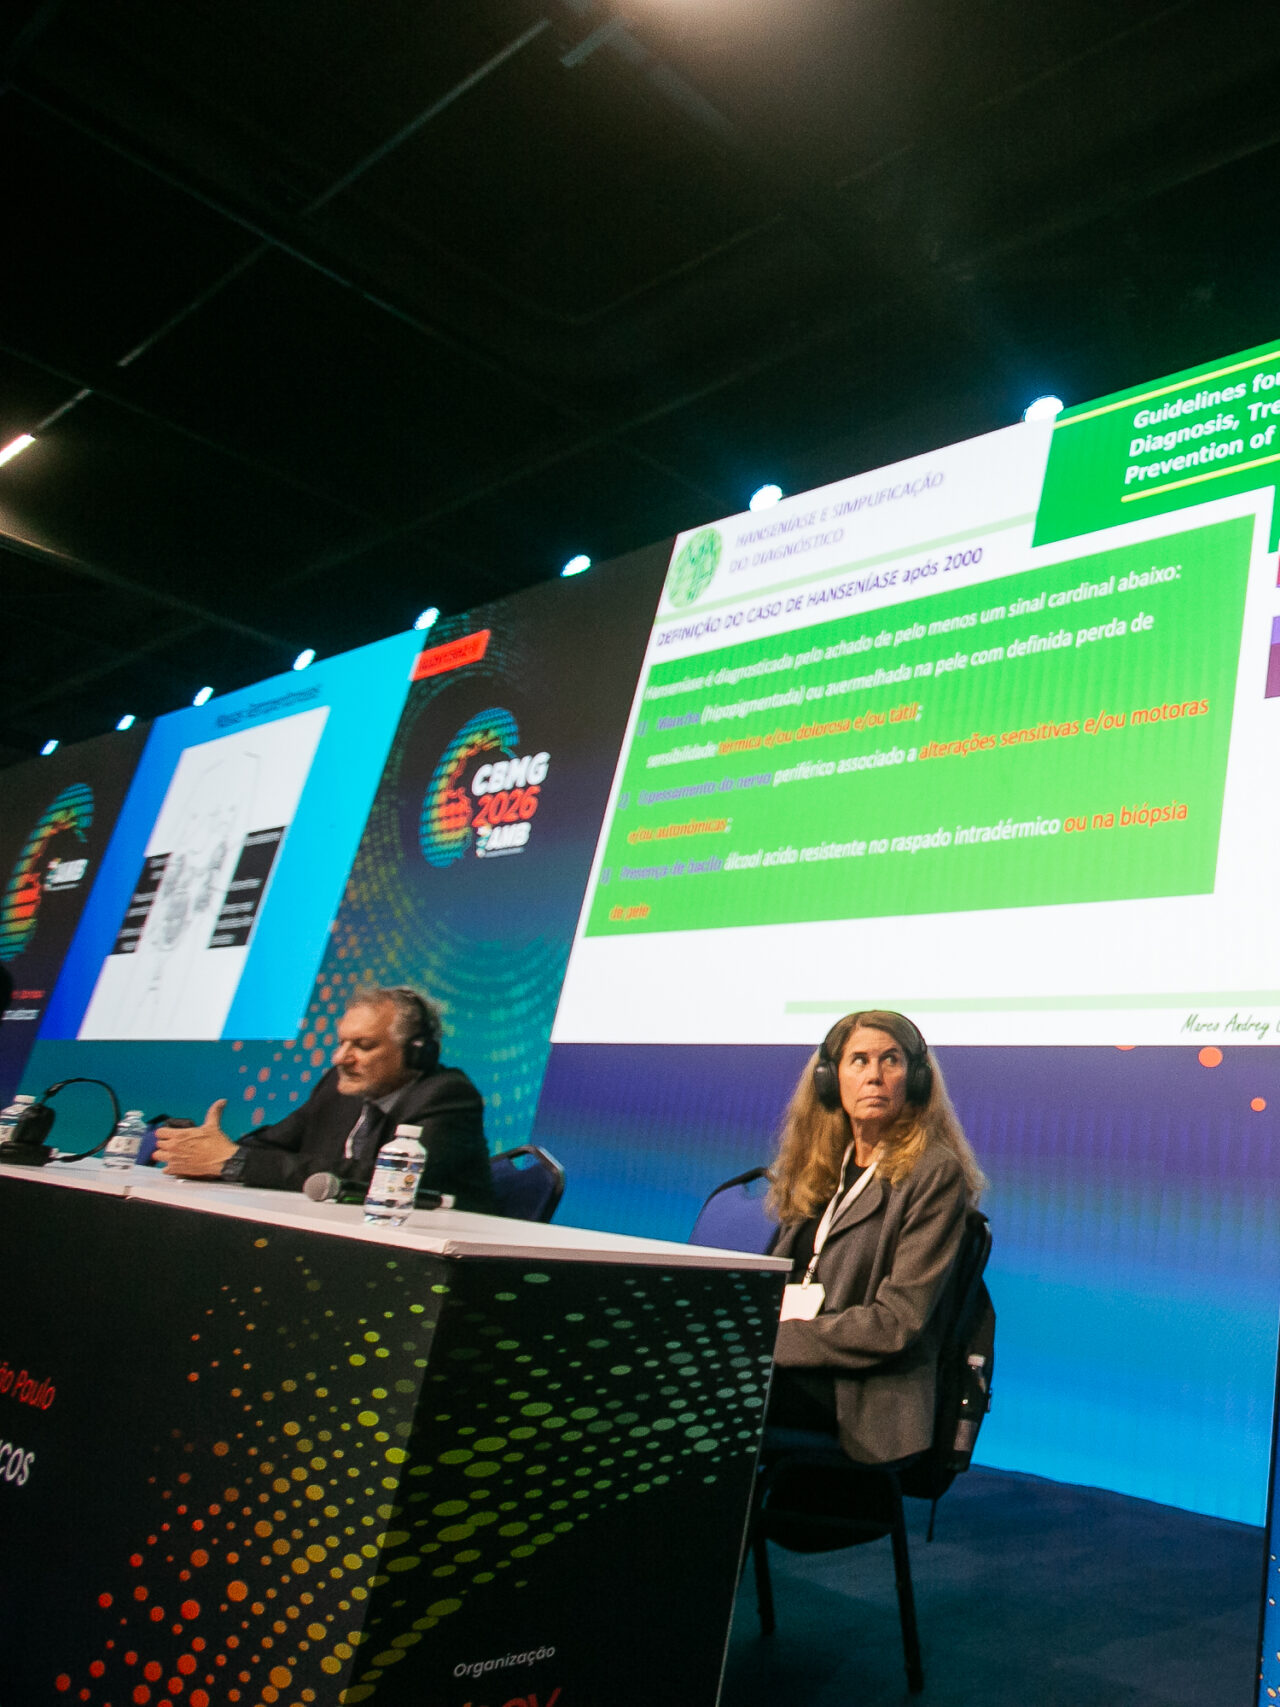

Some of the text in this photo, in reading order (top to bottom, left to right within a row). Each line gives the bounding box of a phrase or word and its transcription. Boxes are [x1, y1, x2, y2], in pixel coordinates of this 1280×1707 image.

[1133, 382, 1246, 430] Guidelines
[1124, 439, 1244, 485] Prevention
[1250, 424, 1276, 449] of
[1128, 413, 1241, 458] Diagnosis,
[736, 471, 945, 549] HANSENÍASE E SIMPLIFICAÇÃO
[729, 527, 845, 574] DO DIAGNÓSTICO
[657, 547, 983, 646] DEFINIÇÃO DO CASO DE HANSENÍASE após 2000
[794, 646, 824, 669] pelo
[824, 635, 873, 660] achado
[874, 630, 893, 648] de
[894, 623, 926, 648] pelo
[928, 613, 977, 636] menos
[979, 606, 1005, 625] um
[1008, 592, 1045, 618] sinal
[1048, 576, 1115, 609] cardinal
[1117, 564, 1182, 593] abaixo:
[806, 685, 825, 701] ou
[825, 663, 911, 697] avermelhada
[913, 662, 933, 679] na
[935, 652, 967, 677] pele
[970, 645, 1004, 667] com
[1006, 628, 1073, 659] definida
[1075, 618, 1127, 648] perda
[1130, 611, 1154, 634] de
[764, 728, 793, 748] e/ou
[795, 719, 851, 742] dolorosa
[853, 710, 885, 731] e/ou
[889, 702, 923, 723] tátil;
[772, 759, 836, 788] periférico
[836, 746, 906, 774] associado
[907, 747, 918, 763] a
[918, 732, 996, 761] alterações
[999, 720, 1079, 747] sensitivas
[1084, 710, 1126, 736] e/ou
[1131, 699, 1209, 726] motoras
[472, 751, 550, 797] CBMG
[472, 785, 541, 828] 2026
[799, 840, 866, 862] resistente
[868, 838, 888, 855] no
[890, 828, 951, 854] raspado
[954, 815, 1060, 846] intradérmico
[1063, 815, 1087, 833] ou
[1092, 811, 1114, 829] na
[1119, 800, 1188, 829] biópsia
[1180, 1013, 1220, 1033] Marco
[1224, 1013, 1270, 1041] Andrey
[10, 1369, 56, 1410] Paulo
[453, 1646, 556, 1678] Organização
